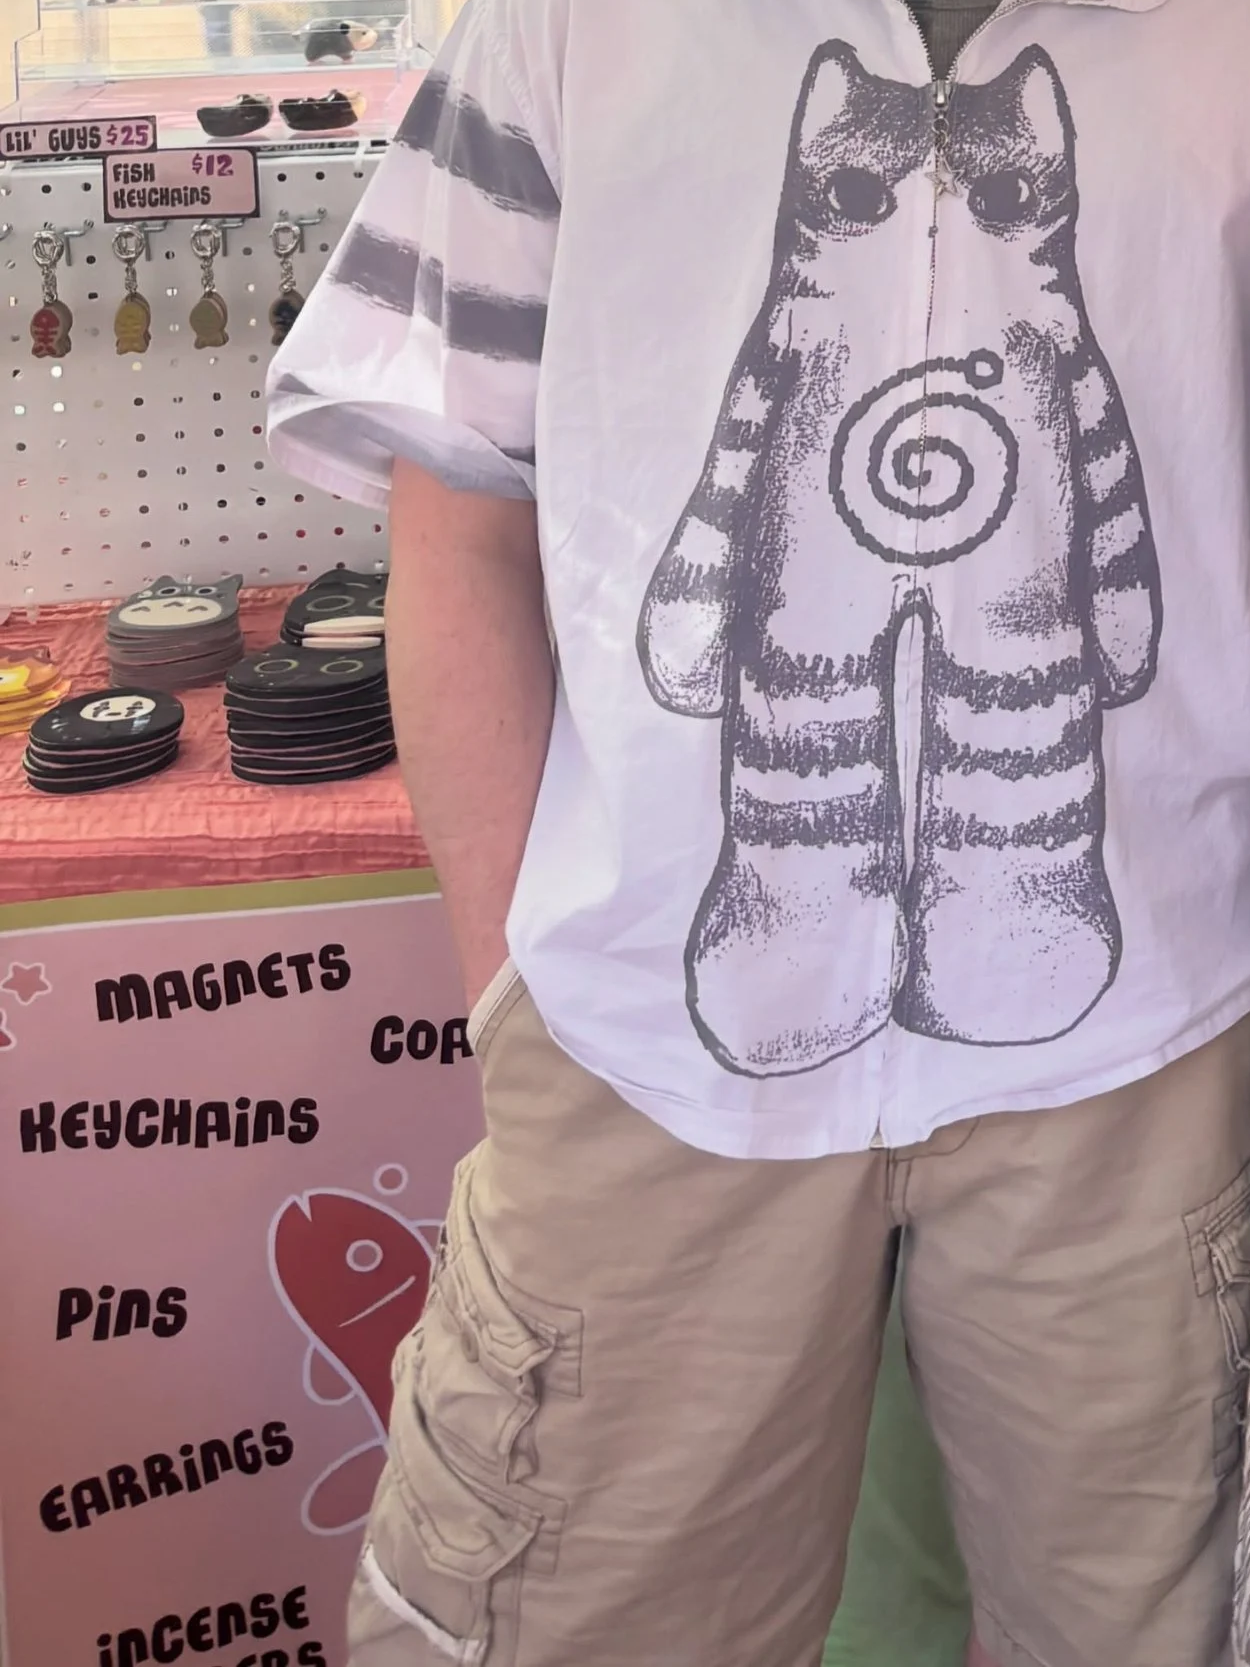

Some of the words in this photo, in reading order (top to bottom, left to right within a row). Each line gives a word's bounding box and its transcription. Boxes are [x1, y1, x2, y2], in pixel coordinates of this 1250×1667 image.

[49, 126, 101, 151] GUYS
[106, 124, 149, 146] $25
[192, 153, 234, 177] $12
[95, 943, 351, 1023] MAGNETS
[370, 1015, 474, 1064] COA
